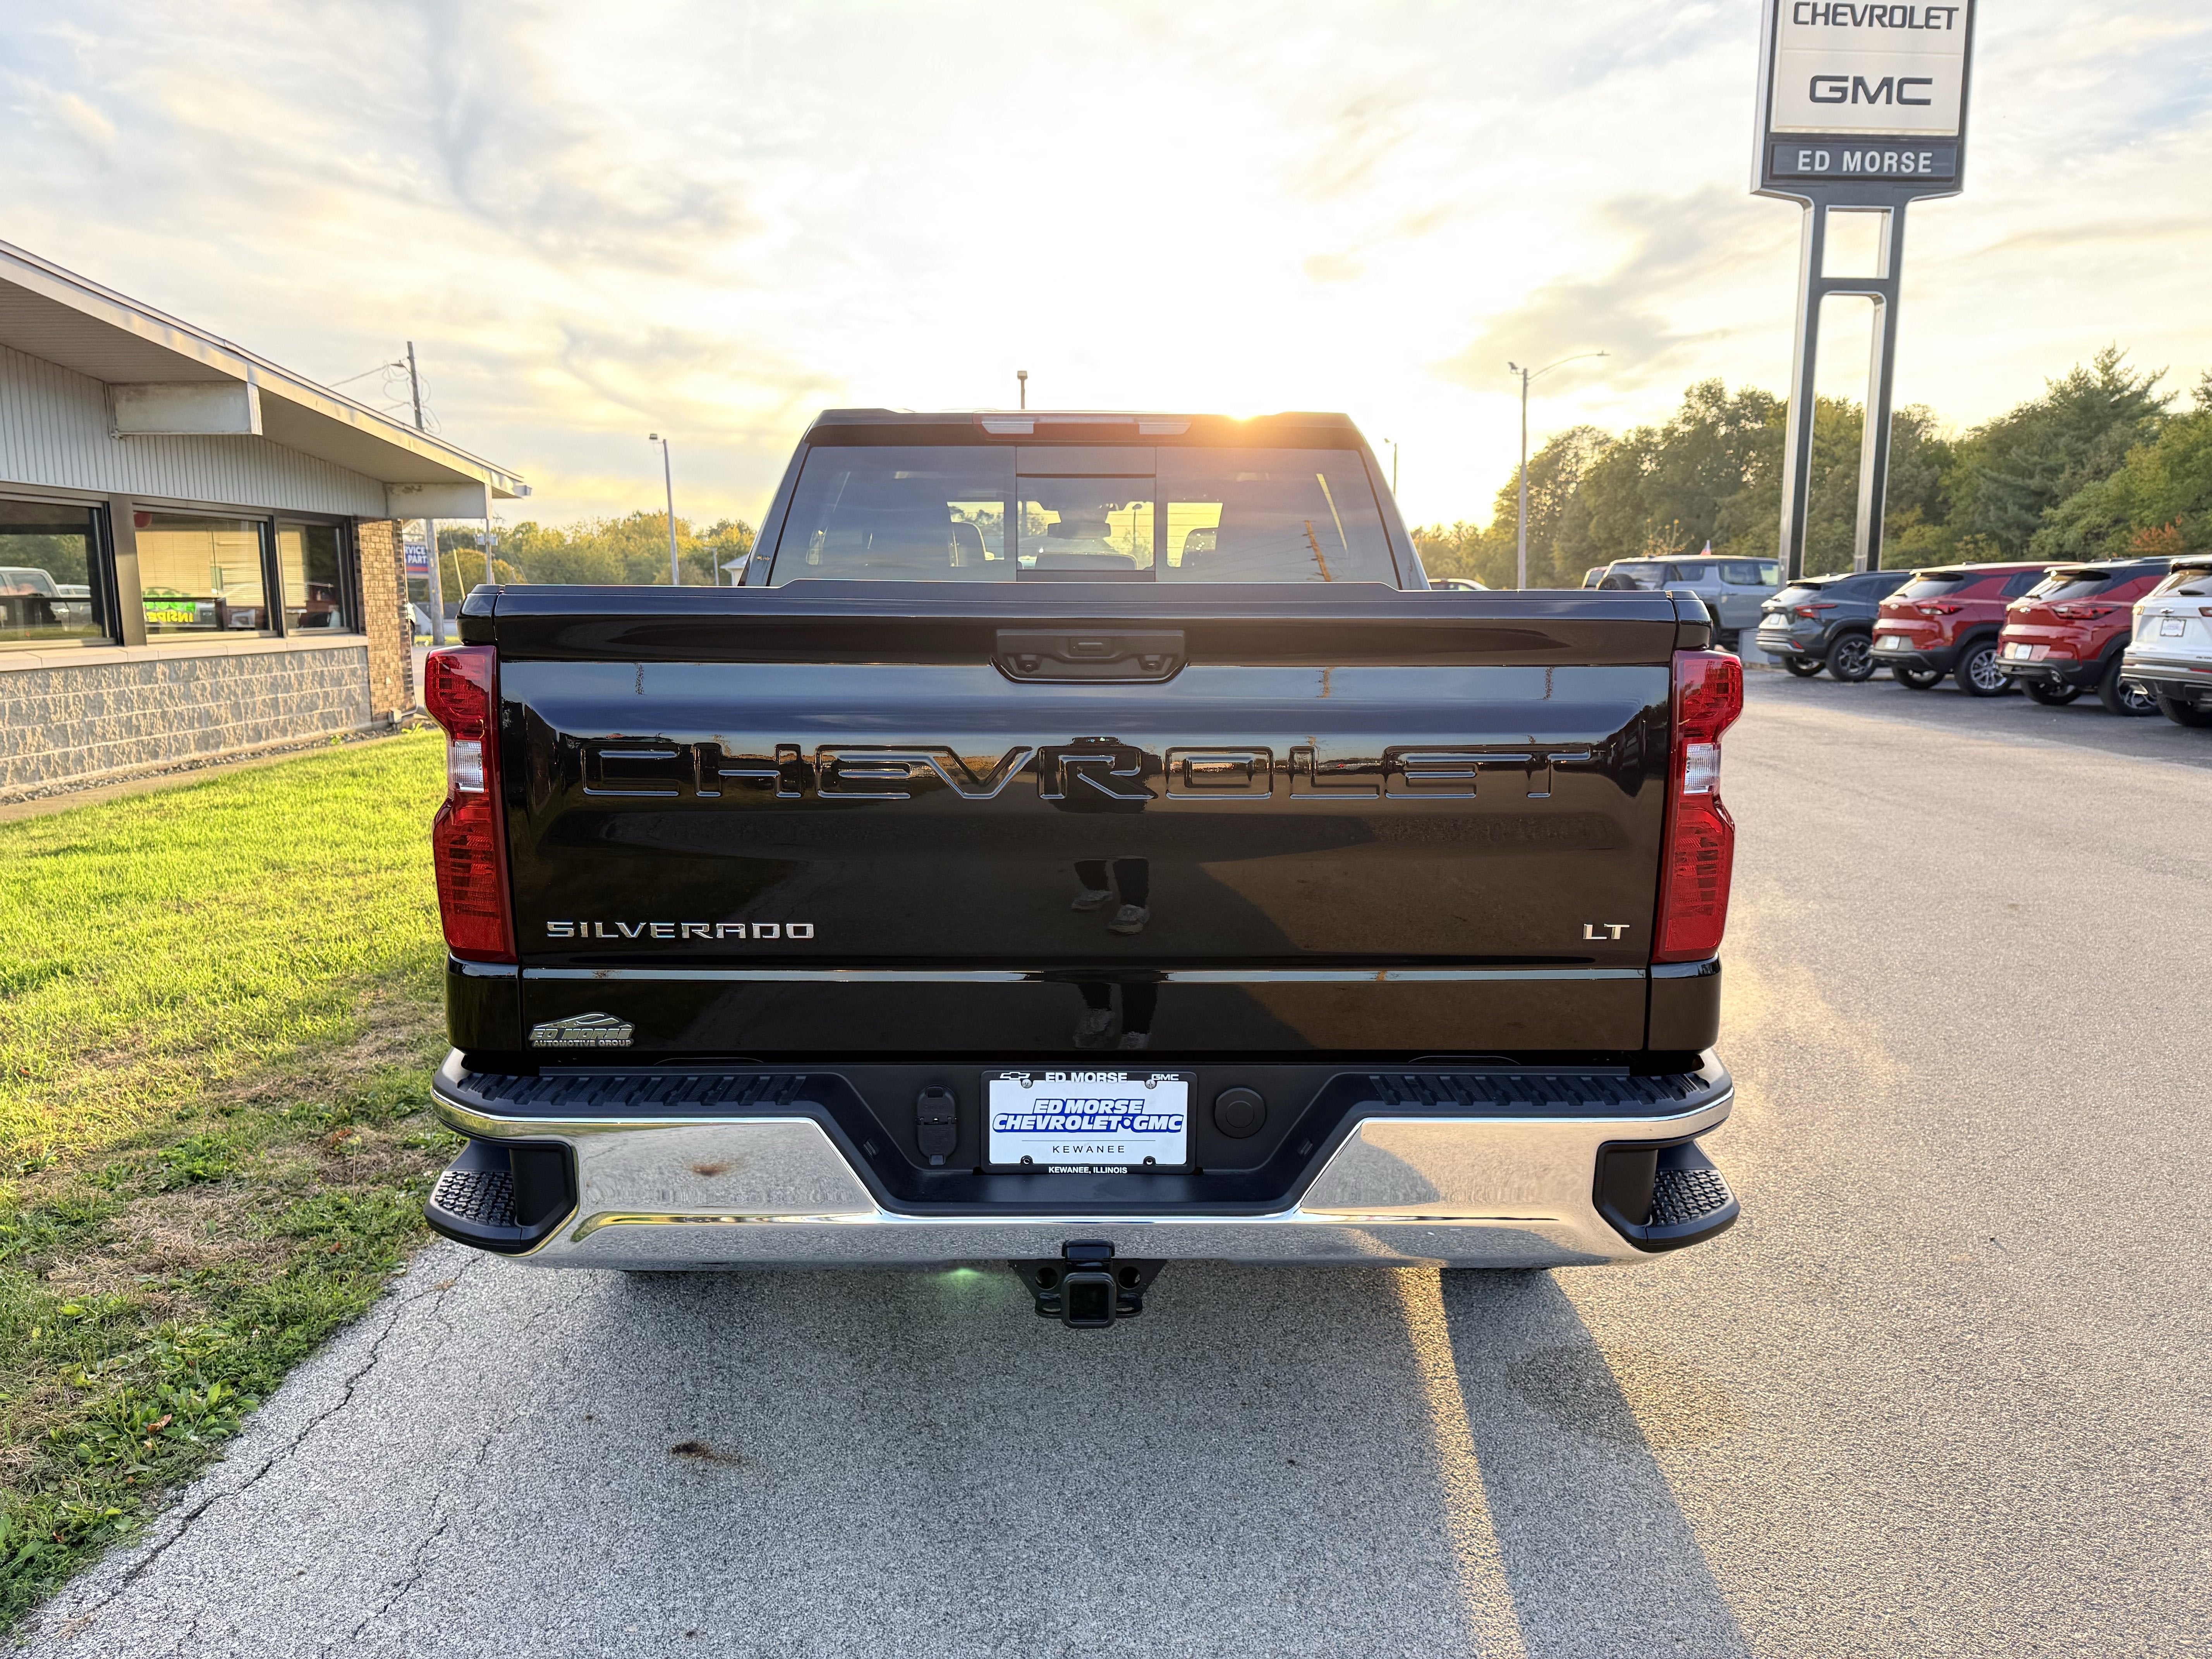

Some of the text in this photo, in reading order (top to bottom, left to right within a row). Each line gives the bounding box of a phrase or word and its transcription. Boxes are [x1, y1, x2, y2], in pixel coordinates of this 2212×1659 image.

[1793, 1, 1960, 30] CHEVROLET
[1809, 75, 1933, 106] GMC
[1797, 150, 1933, 173] ED MORSE
[408, 554, 427, 564] PART
[580, 742, 1592, 799] CHEVROLET
[546, 921, 814, 939] SILVERADO
[1583, 923, 1630, 940] LT
[529, 1028, 632, 1040] ED MORSE
[1045, 1072, 1128, 1084] ED MORSE
[1033, 1099, 1145, 1114] ED MORSE
[1052, 1145, 1125, 1153] KEWANEE
